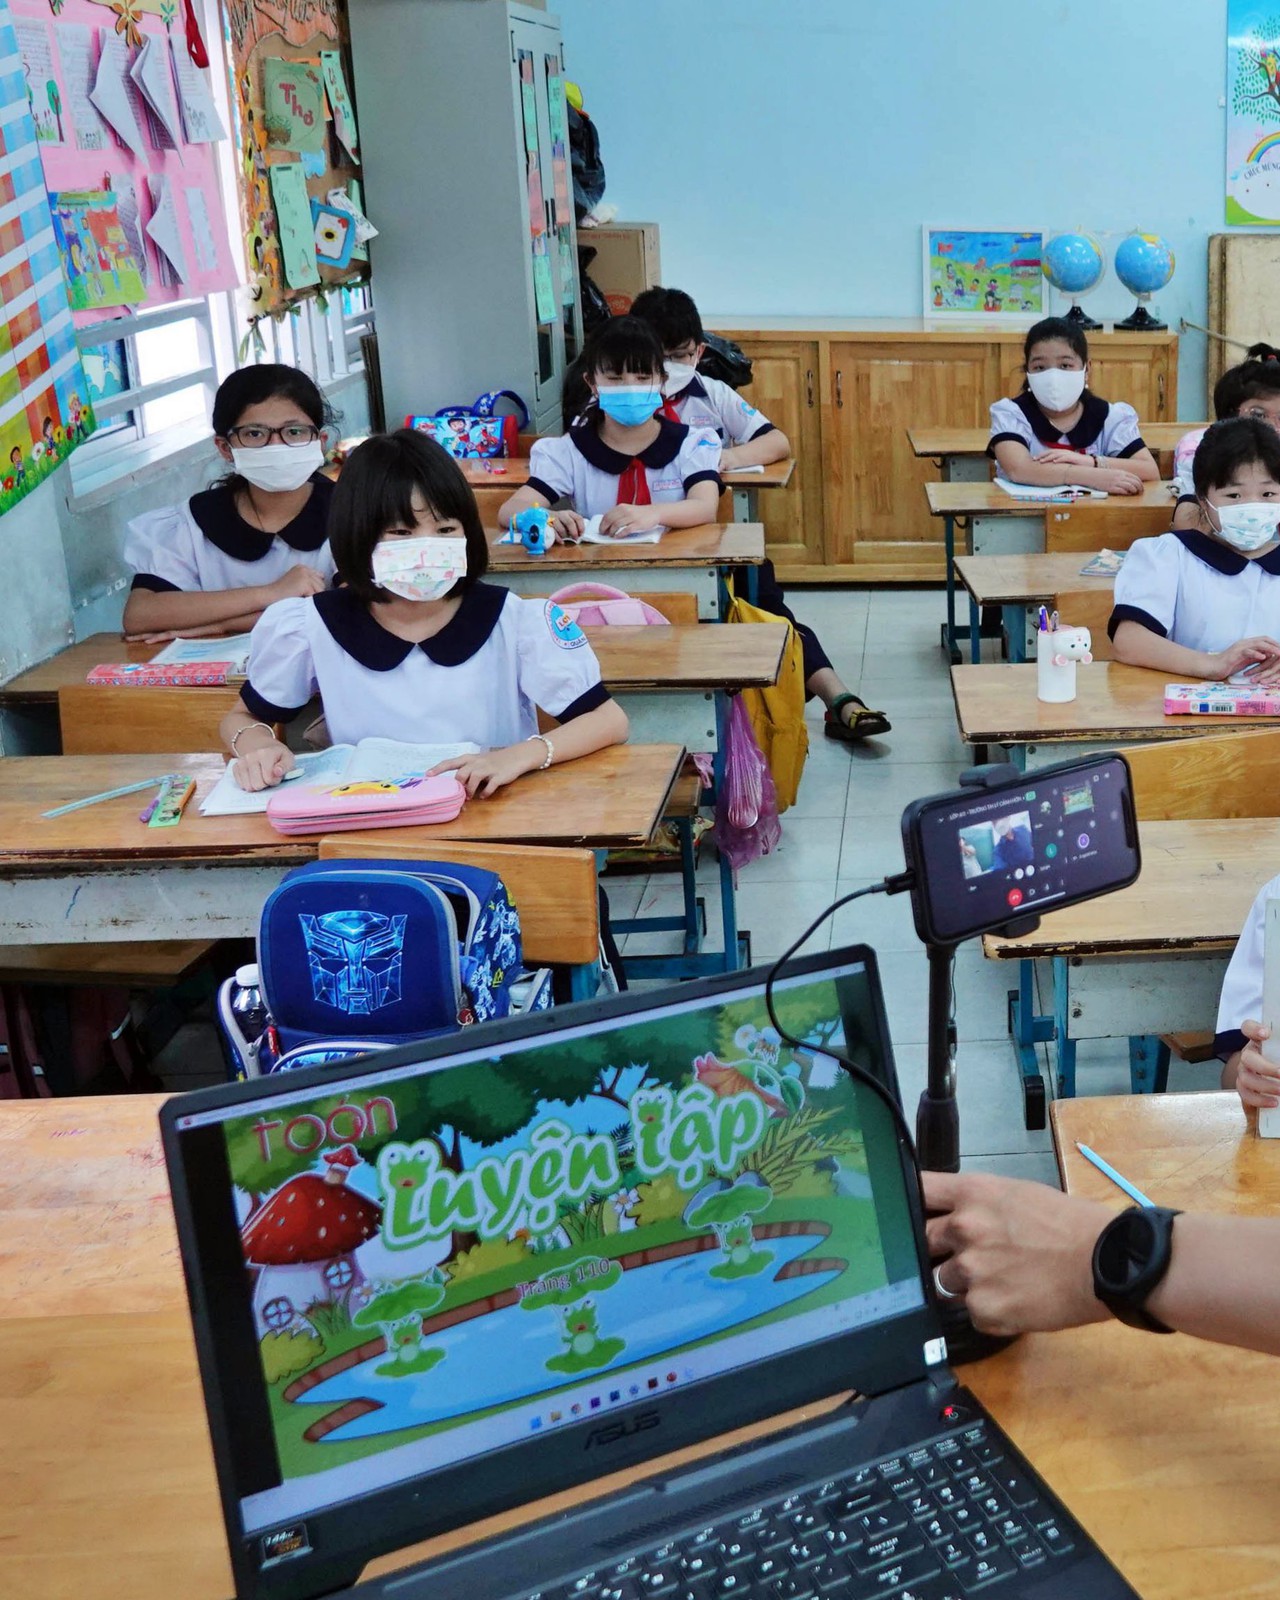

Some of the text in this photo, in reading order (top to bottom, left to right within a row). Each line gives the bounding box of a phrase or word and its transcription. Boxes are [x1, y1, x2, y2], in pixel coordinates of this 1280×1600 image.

[516, 1258, 610, 1299] Trang 110
[584, 1410, 661, 1450] ASUS
